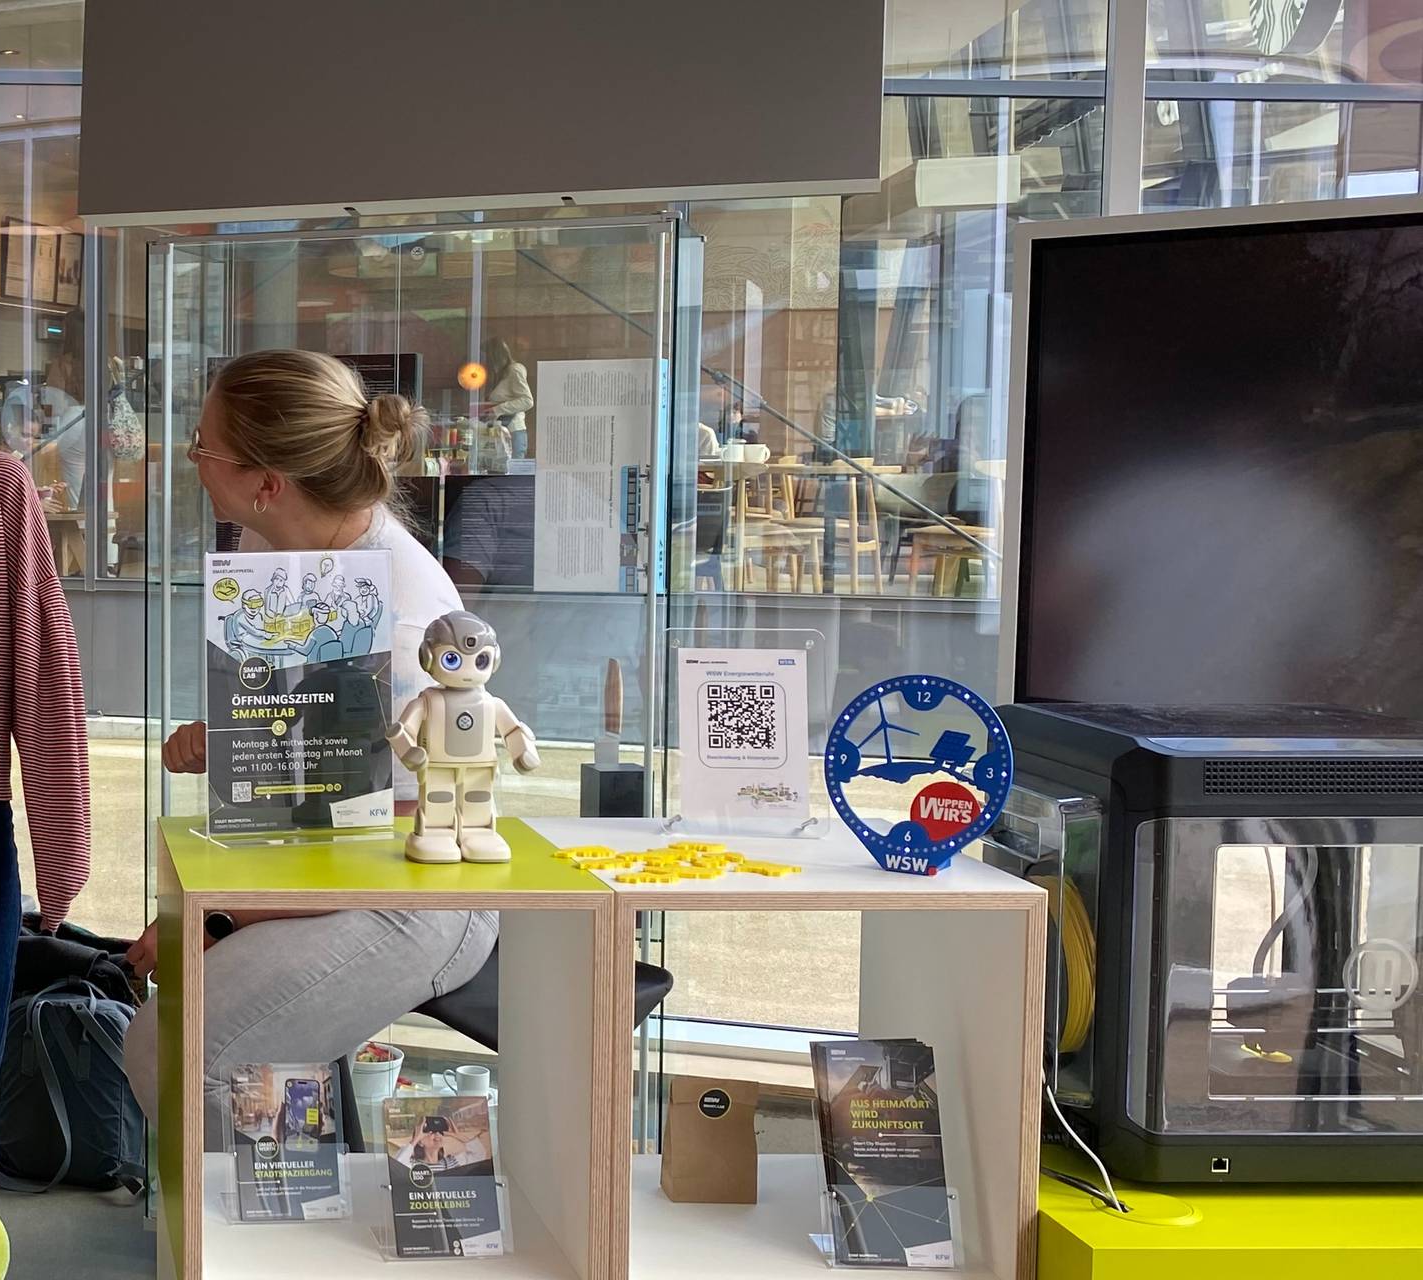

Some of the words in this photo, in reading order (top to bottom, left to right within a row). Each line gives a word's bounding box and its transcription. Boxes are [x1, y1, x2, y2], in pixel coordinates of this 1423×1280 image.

[232, 693, 334, 706] ÖFFNUNGSZEITEN
[917, 691, 931, 703] 12
[232, 708, 296, 719] SMART.LAB
[232, 739, 269, 750] Montags
[271, 739, 278, 747] &
[280, 737, 323, 748] mittwochs
[325, 737, 348, 745] sowie
[232, 752, 255, 762] jeden
[257, 752, 283, 760] ersten
[285, 749, 321, 760] Samstag
[323, 749, 334, 757] im
[336, 748, 363, 757] Monat
[840, 754, 847, 765] 9
[232, 765, 247, 773] von
[302, 762, 318, 770] Uhr
[986, 767, 994, 779] 3
[904, 830, 912, 842] 6
[885, 855, 929, 872] WSW
[850, 1100, 870, 1109] AUS
[873, 1100, 930, 1109] HEIMATORT
[850, 1110, 877, 1119] WIRD
[852, 1120, 924, 1130] ZUKUNFTSORT
[254, 1162, 267, 1170] EIN
[269, 1161, 315, 1169] VIRTUELLER
[255, 1169, 333, 1178] STADTSPAZIERGANG
[409, 1191, 424, 1200] EIN
[426, 1190, 477, 1200] VIRTUELLES
[410, 1200, 471, 1210] ZOOERLEBNIS
